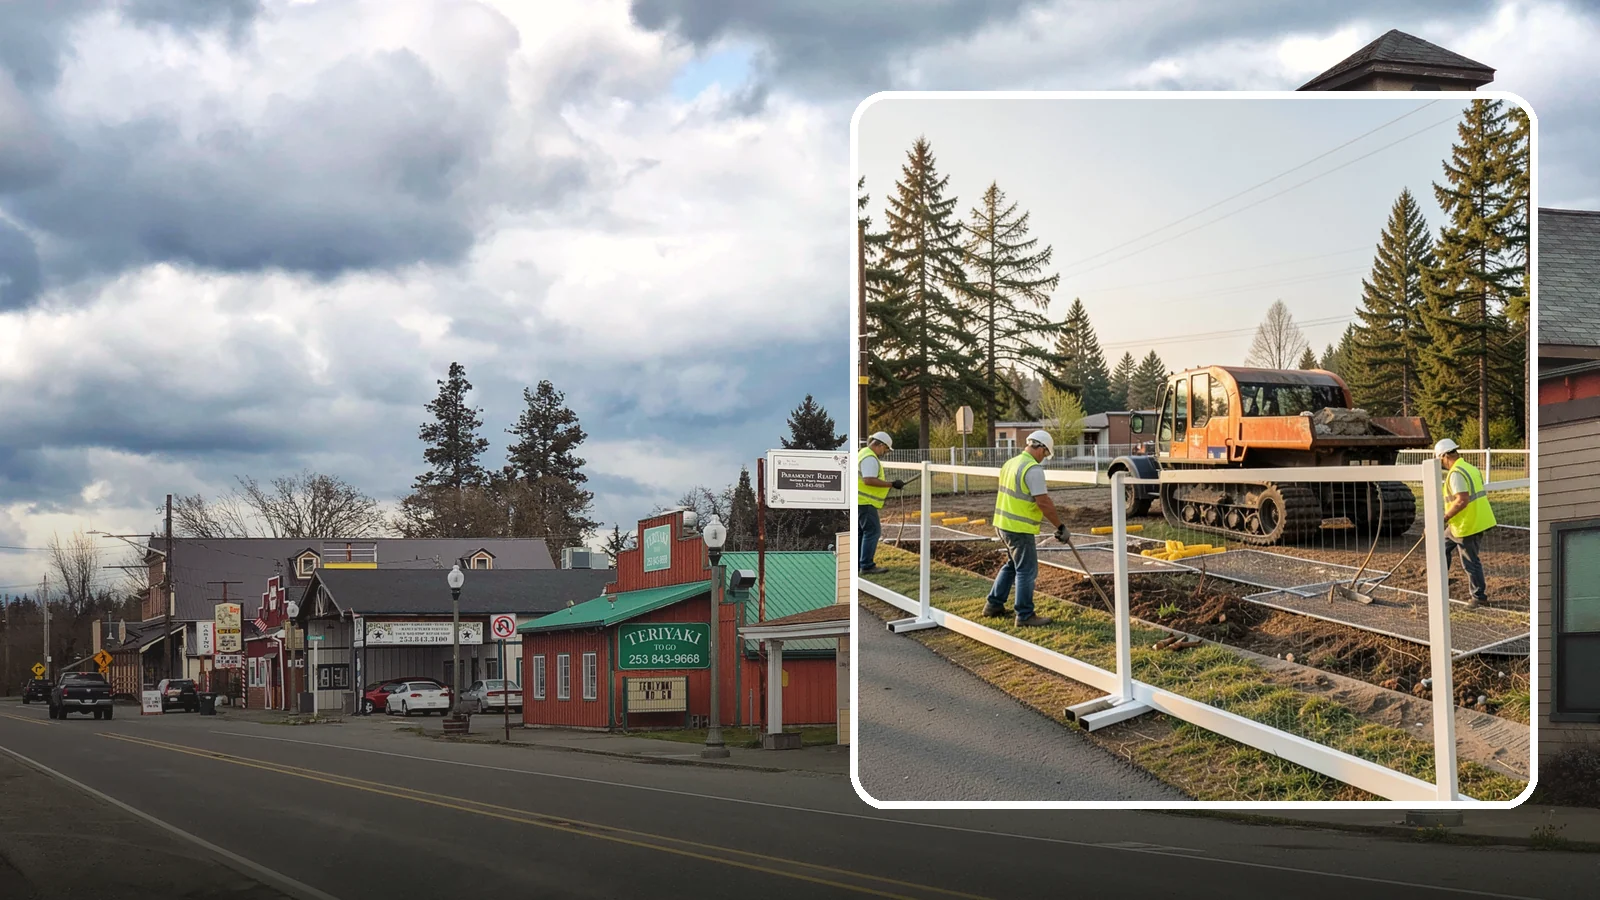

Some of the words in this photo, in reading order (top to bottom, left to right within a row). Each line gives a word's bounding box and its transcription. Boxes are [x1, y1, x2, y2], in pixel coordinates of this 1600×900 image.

[781, 471, 815, 479] PARAMOUNT
[817, 472, 839, 480] REALTY
[625, 627, 702, 646] TERIYAKI
[628, 654, 649, 665] 253
[651, 653, 700, 664] 843-9668
